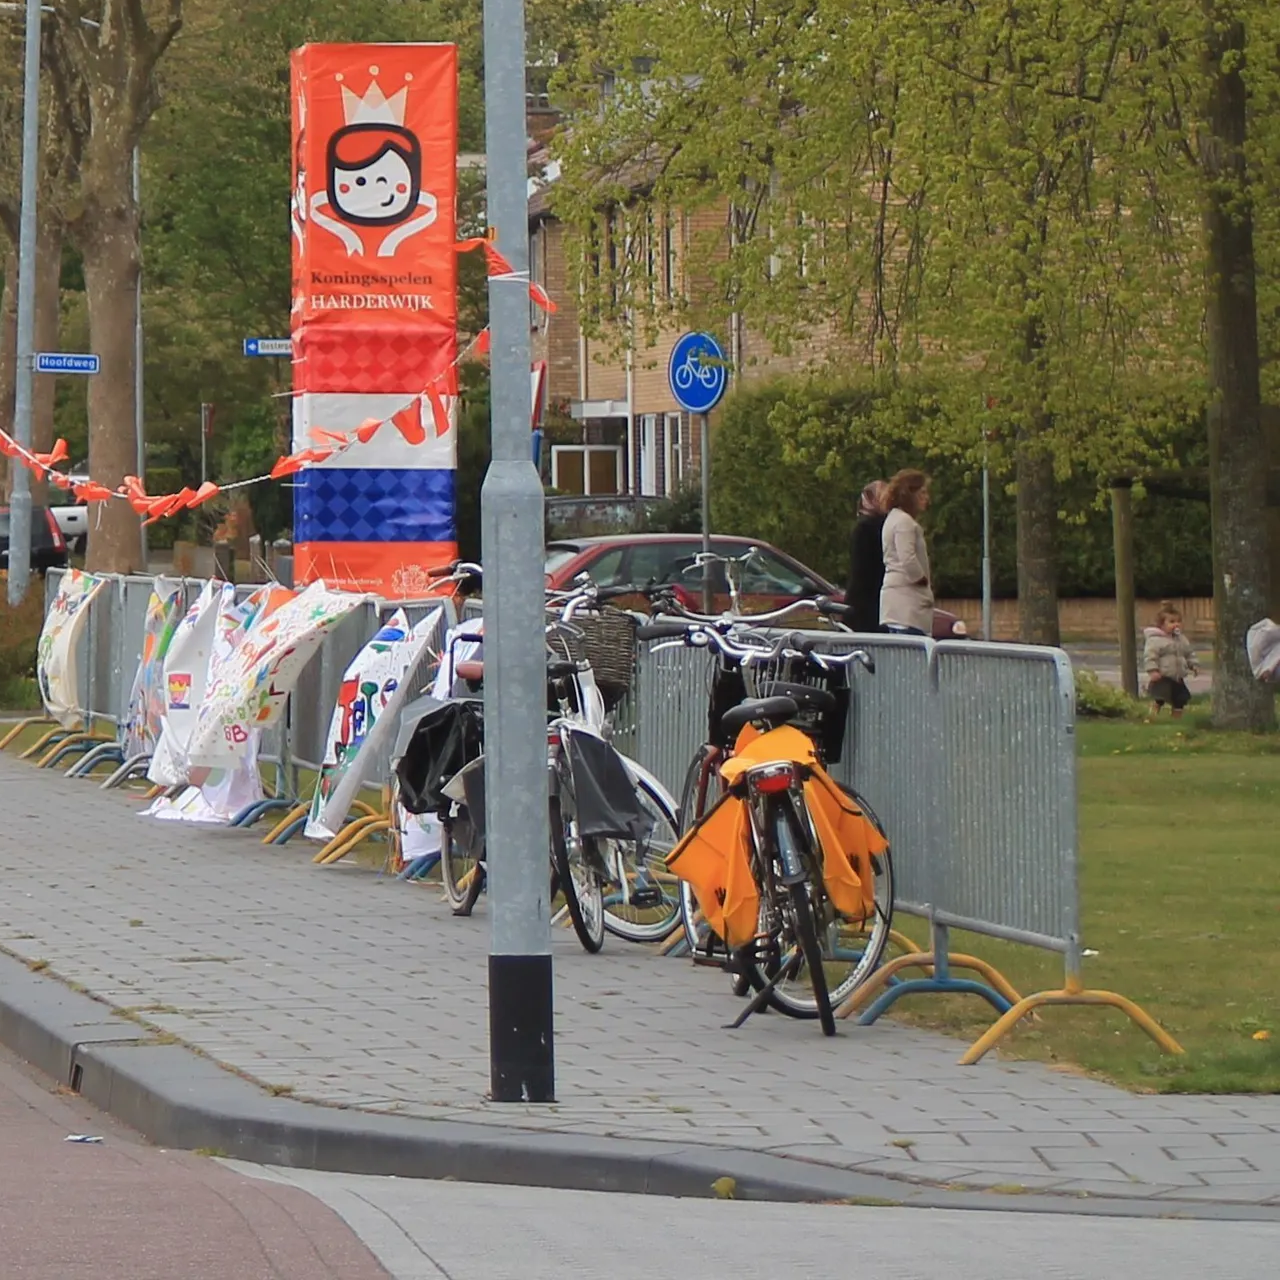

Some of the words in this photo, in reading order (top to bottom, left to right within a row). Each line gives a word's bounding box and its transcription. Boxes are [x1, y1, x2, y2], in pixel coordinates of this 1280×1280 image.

[310, 271, 433, 287] Koningsspelen
[310, 293, 434, 311] HARDERWIJK
[41, 356, 96, 370] Hoofdweg
